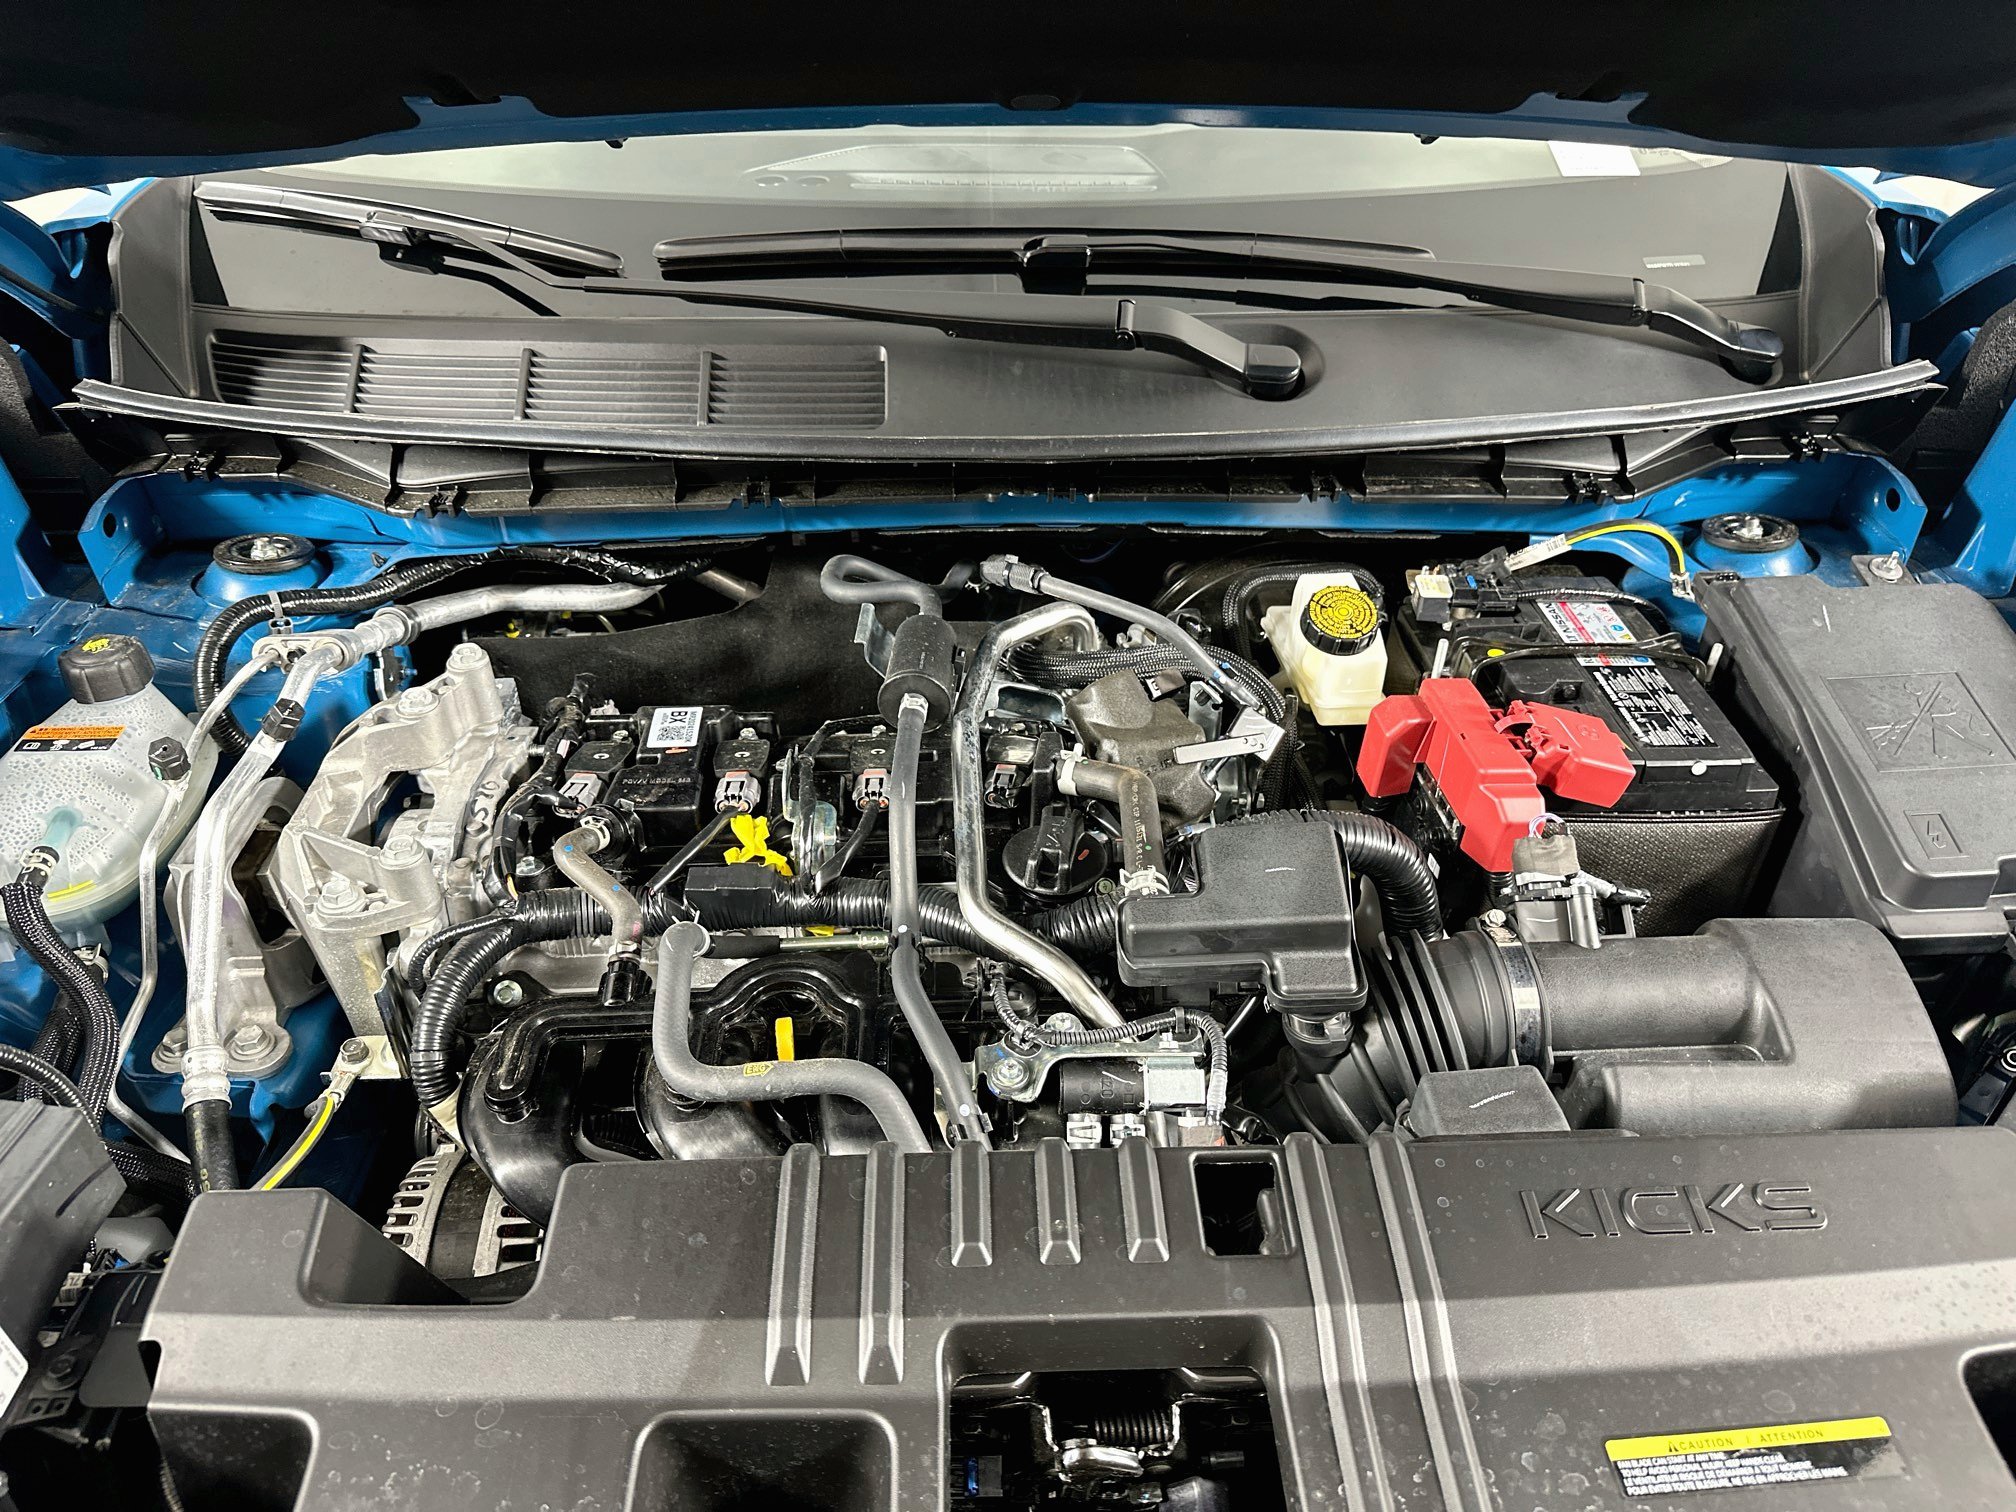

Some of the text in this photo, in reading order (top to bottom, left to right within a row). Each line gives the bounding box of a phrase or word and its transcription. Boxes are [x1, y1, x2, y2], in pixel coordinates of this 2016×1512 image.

[669, 711, 688, 724] BX
[1520, 1182, 1828, 1239] KICKS
[1680, 1438, 1733, 1451] CAUTION
[1760, 1429, 1824, 1443] ATTENTION
